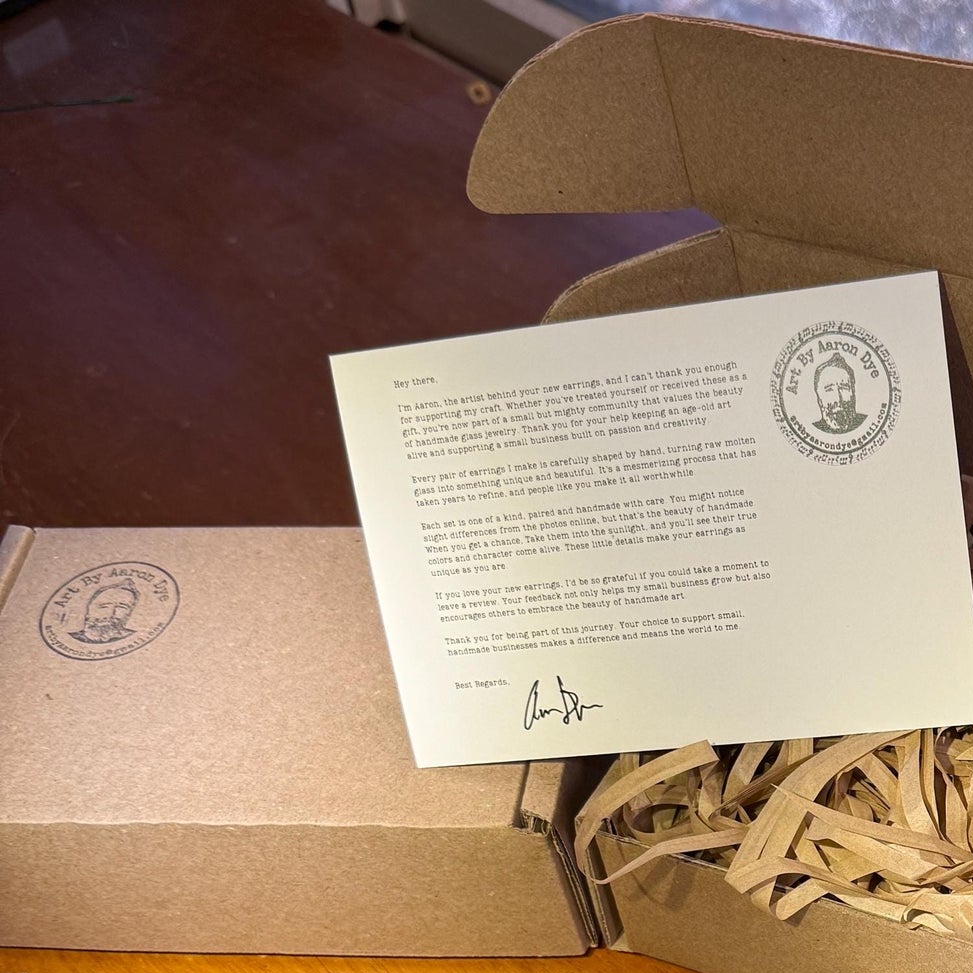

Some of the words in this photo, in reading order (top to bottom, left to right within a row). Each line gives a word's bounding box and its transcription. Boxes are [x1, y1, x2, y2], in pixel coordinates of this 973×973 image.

[393, 379, 410, 389] Hey
[443, 398, 458, 406] the
[460, 394, 485, 404] artist
[486, 389, 517, 401] behind
[519, 387, 540, 398] your
[542, 384, 560, 394] new
[605, 375, 623, 385] and
[655, 367, 683, 379] thank
[684, 366, 702, 377] you
[704, 360, 738, 373] enough
[786, 368, 802, 395] Art
[796, 348, 814, 367] By
[818, 340, 859, 356] Aaron
[860, 351, 880, 379] Dye
[451, 421, 469, 430] now
[471, 418, 490, 429] part
[491, 416, 500, 425] of
[510, 412, 535, 423] small
[536, 410, 552, 419] but
[554, 406, 586, 418] mighty
[588, 400, 639, 413] community
[641, 396, 661, 406] that
[663, 393, 693, 403] values
[695, 391, 710, 399] the
[712, 386, 744, 397] beauty
[790, 402, 887, 451] artbyaarondye@gmail.com
[411, 474, 437, 484] Every
[439, 472, 457, 482] pair
[458, 469, 467, 478] of
[469, 466, 506, 477] earrings
[513, 462, 538, 472] make
[539, 461, 548, 469] is
[549, 456, 589, 468] carefully
[592, 451, 623, 463] shaped
[625, 450, 637, 460] by
[666, 442, 703, 454] turning
[704, 440, 722, 449] raw
[724, 437, 756, 447] molten
[54, 586, 80, 609] Art
[81, 572, 103, 587] By
[108, 567, 156, 582] Aaron
[153, 579, 170, 603] Dye
[435, 591, 443, 600] If
[444, 592, 461, 601] you
[462, 589, 480, 598] love
[481, 587, 502, 597] your
[504, 585, 522, 594] new
[578, 578, 589, 586] be
[590, 577, 601, 585] so
[602, 572, 638, 585] grateful
[639, 571, 647, 580] if
[649, 571, 666, 580] you
[667, 567, 692, 577] could
[693, 565, 713, 574] take
[722, 560, 759, 572] moment
[760, 560, 770, 568] to
[444, 635, 472, 646] Thank
[473, 635, 489, 644] you
[491, 633, 504, 641] for
[505, 631, 530, 640] being
[531, 628, 550, 639] part
[551, 627, 560, 635] of
[561, 626, 580, 634] this
[618, 621, 640, 629] Your
[641, 618, 669, 627] choice
[681, 613, 716, 624] support
[447, 646, 491, 657] handmade
[491, 642, 539, 652] businesses
[539, 639, 568, 648] makes
[577, 634, 620, 645] difference
[622, 632, 639, 641] and
[640, 630, 669, 639] means
[670, 628, 685, 636] the
[687, 625, 713, 634] world
[714, 624, 724, 632] to
[454, 681, 473, 690] Best
